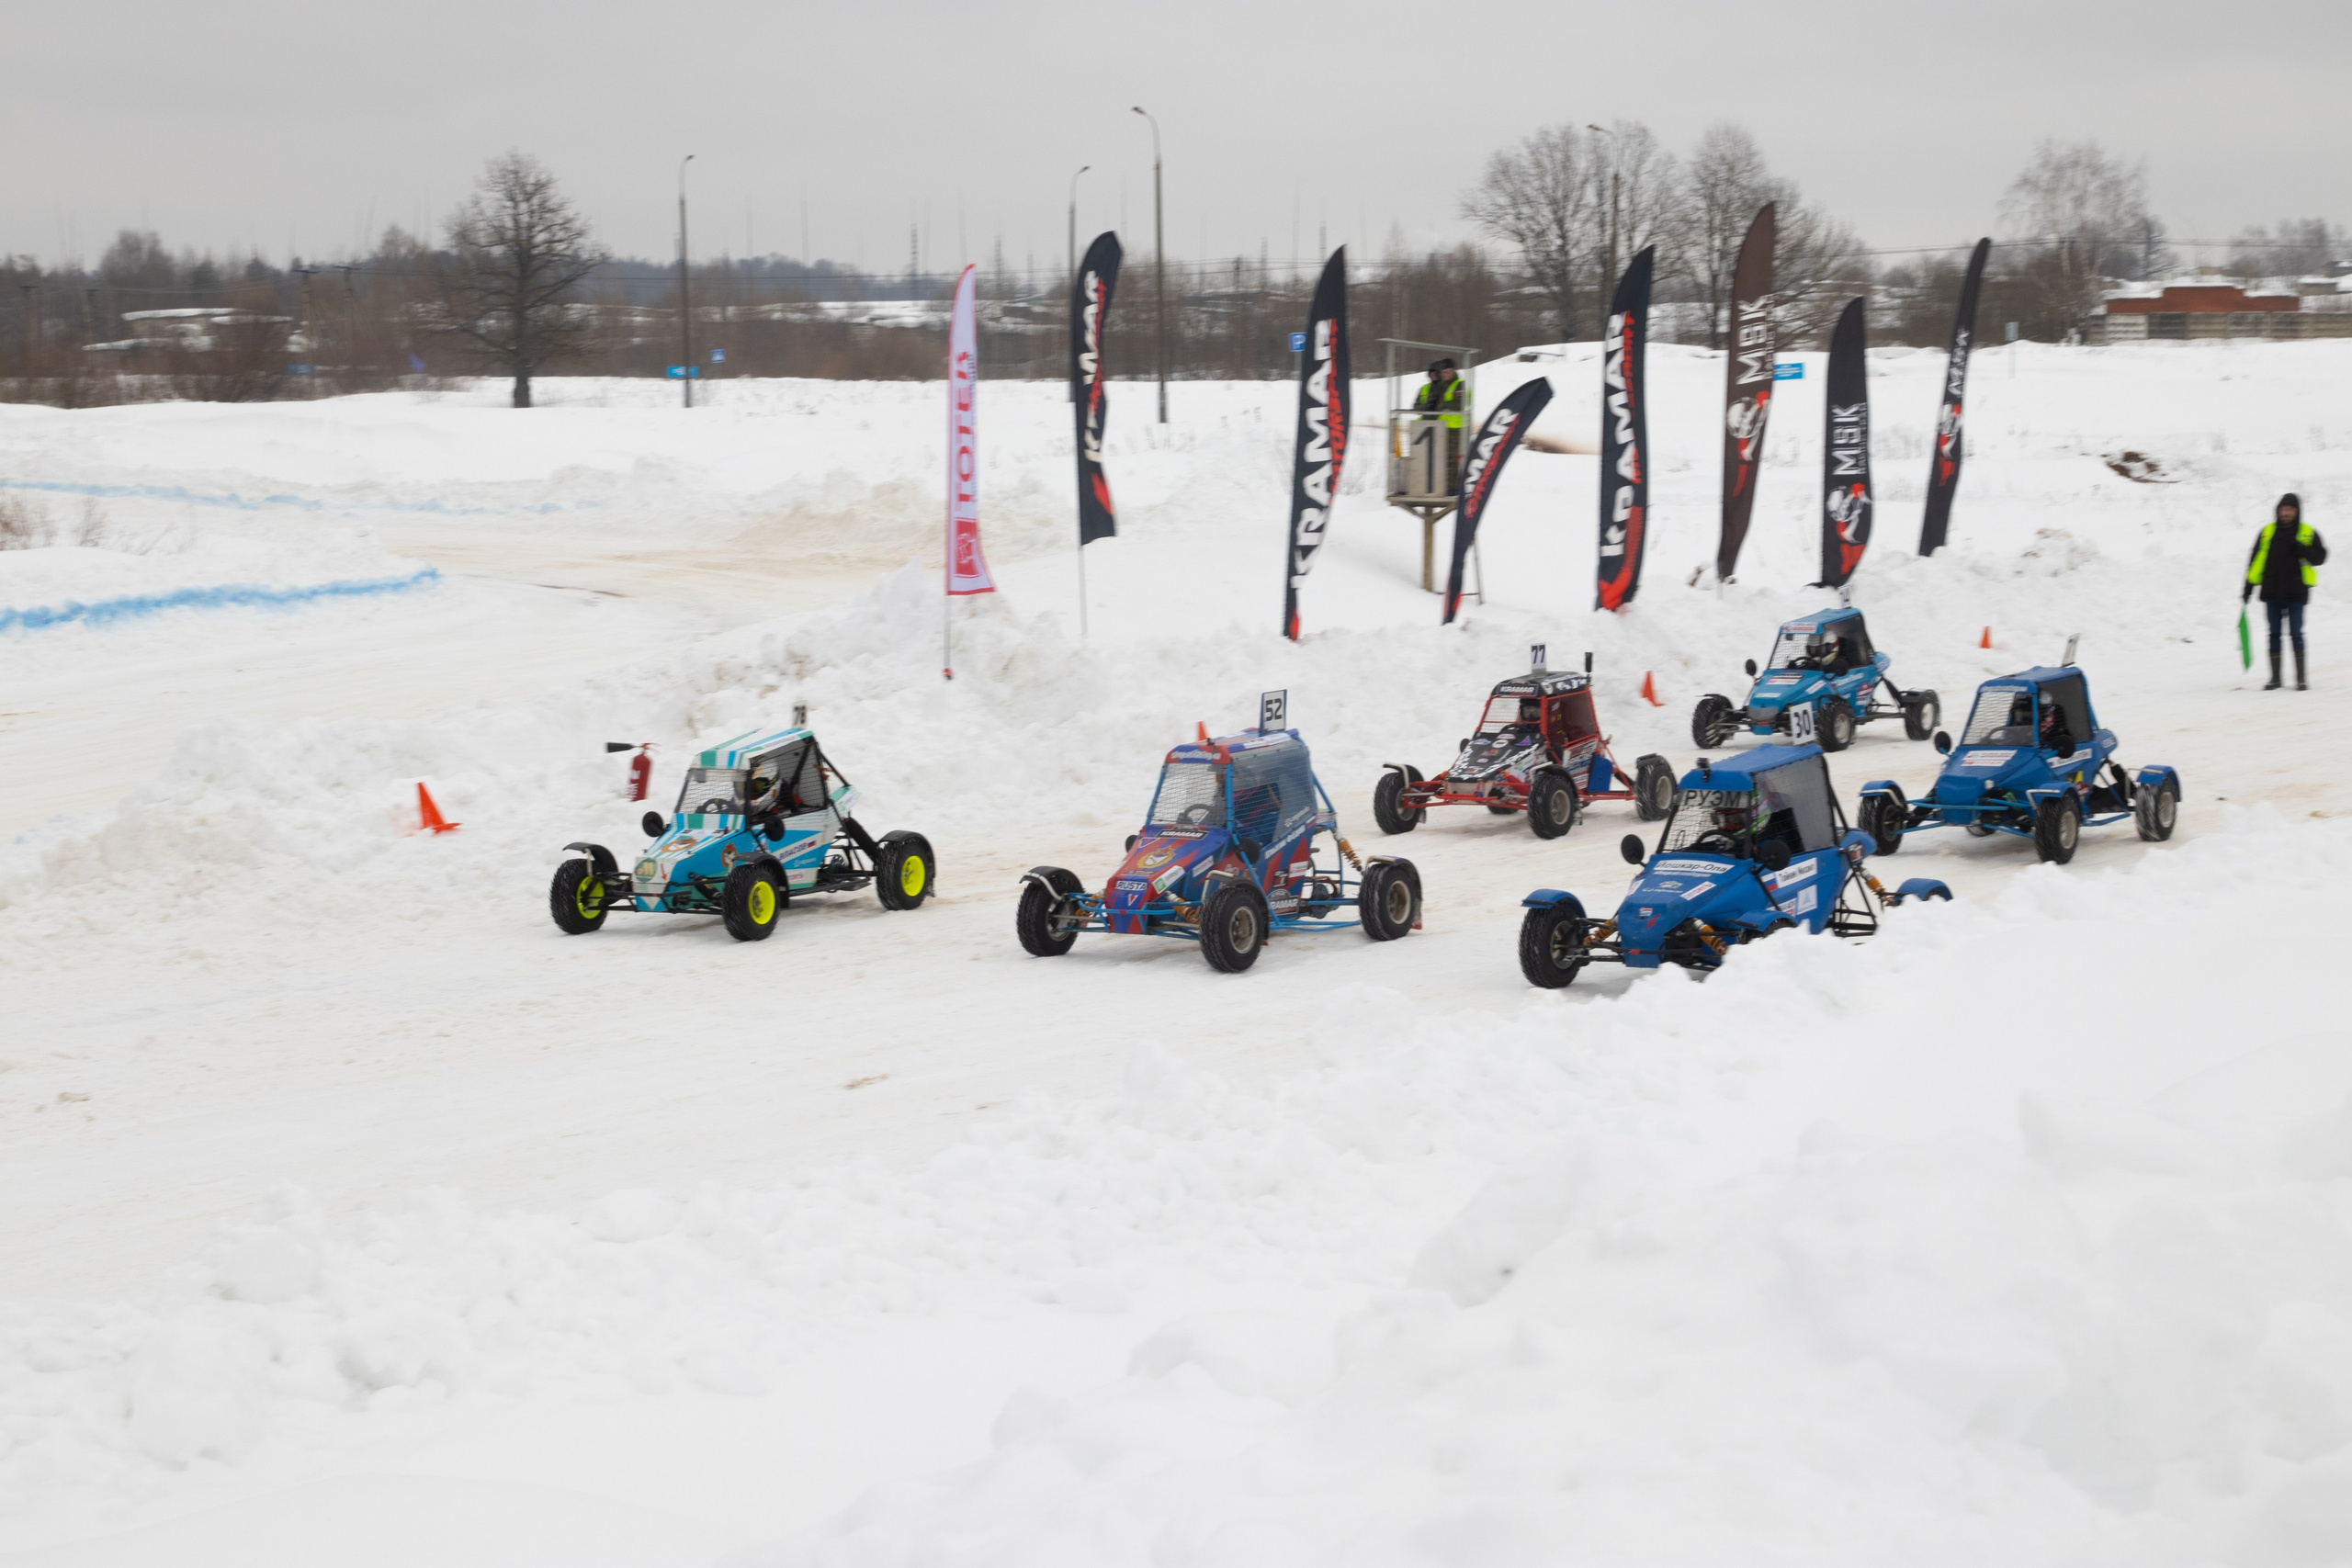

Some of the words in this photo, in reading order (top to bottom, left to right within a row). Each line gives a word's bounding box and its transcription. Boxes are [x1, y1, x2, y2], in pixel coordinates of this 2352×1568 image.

[1292, 320, 1333, 589] KRAMAR
[1413, 425, 1435, 494] 1
[1532, 644, 1545, 664] 77
[1265, 698, 1283, 721] 52
[1793, 708, 1811, 739] 30
